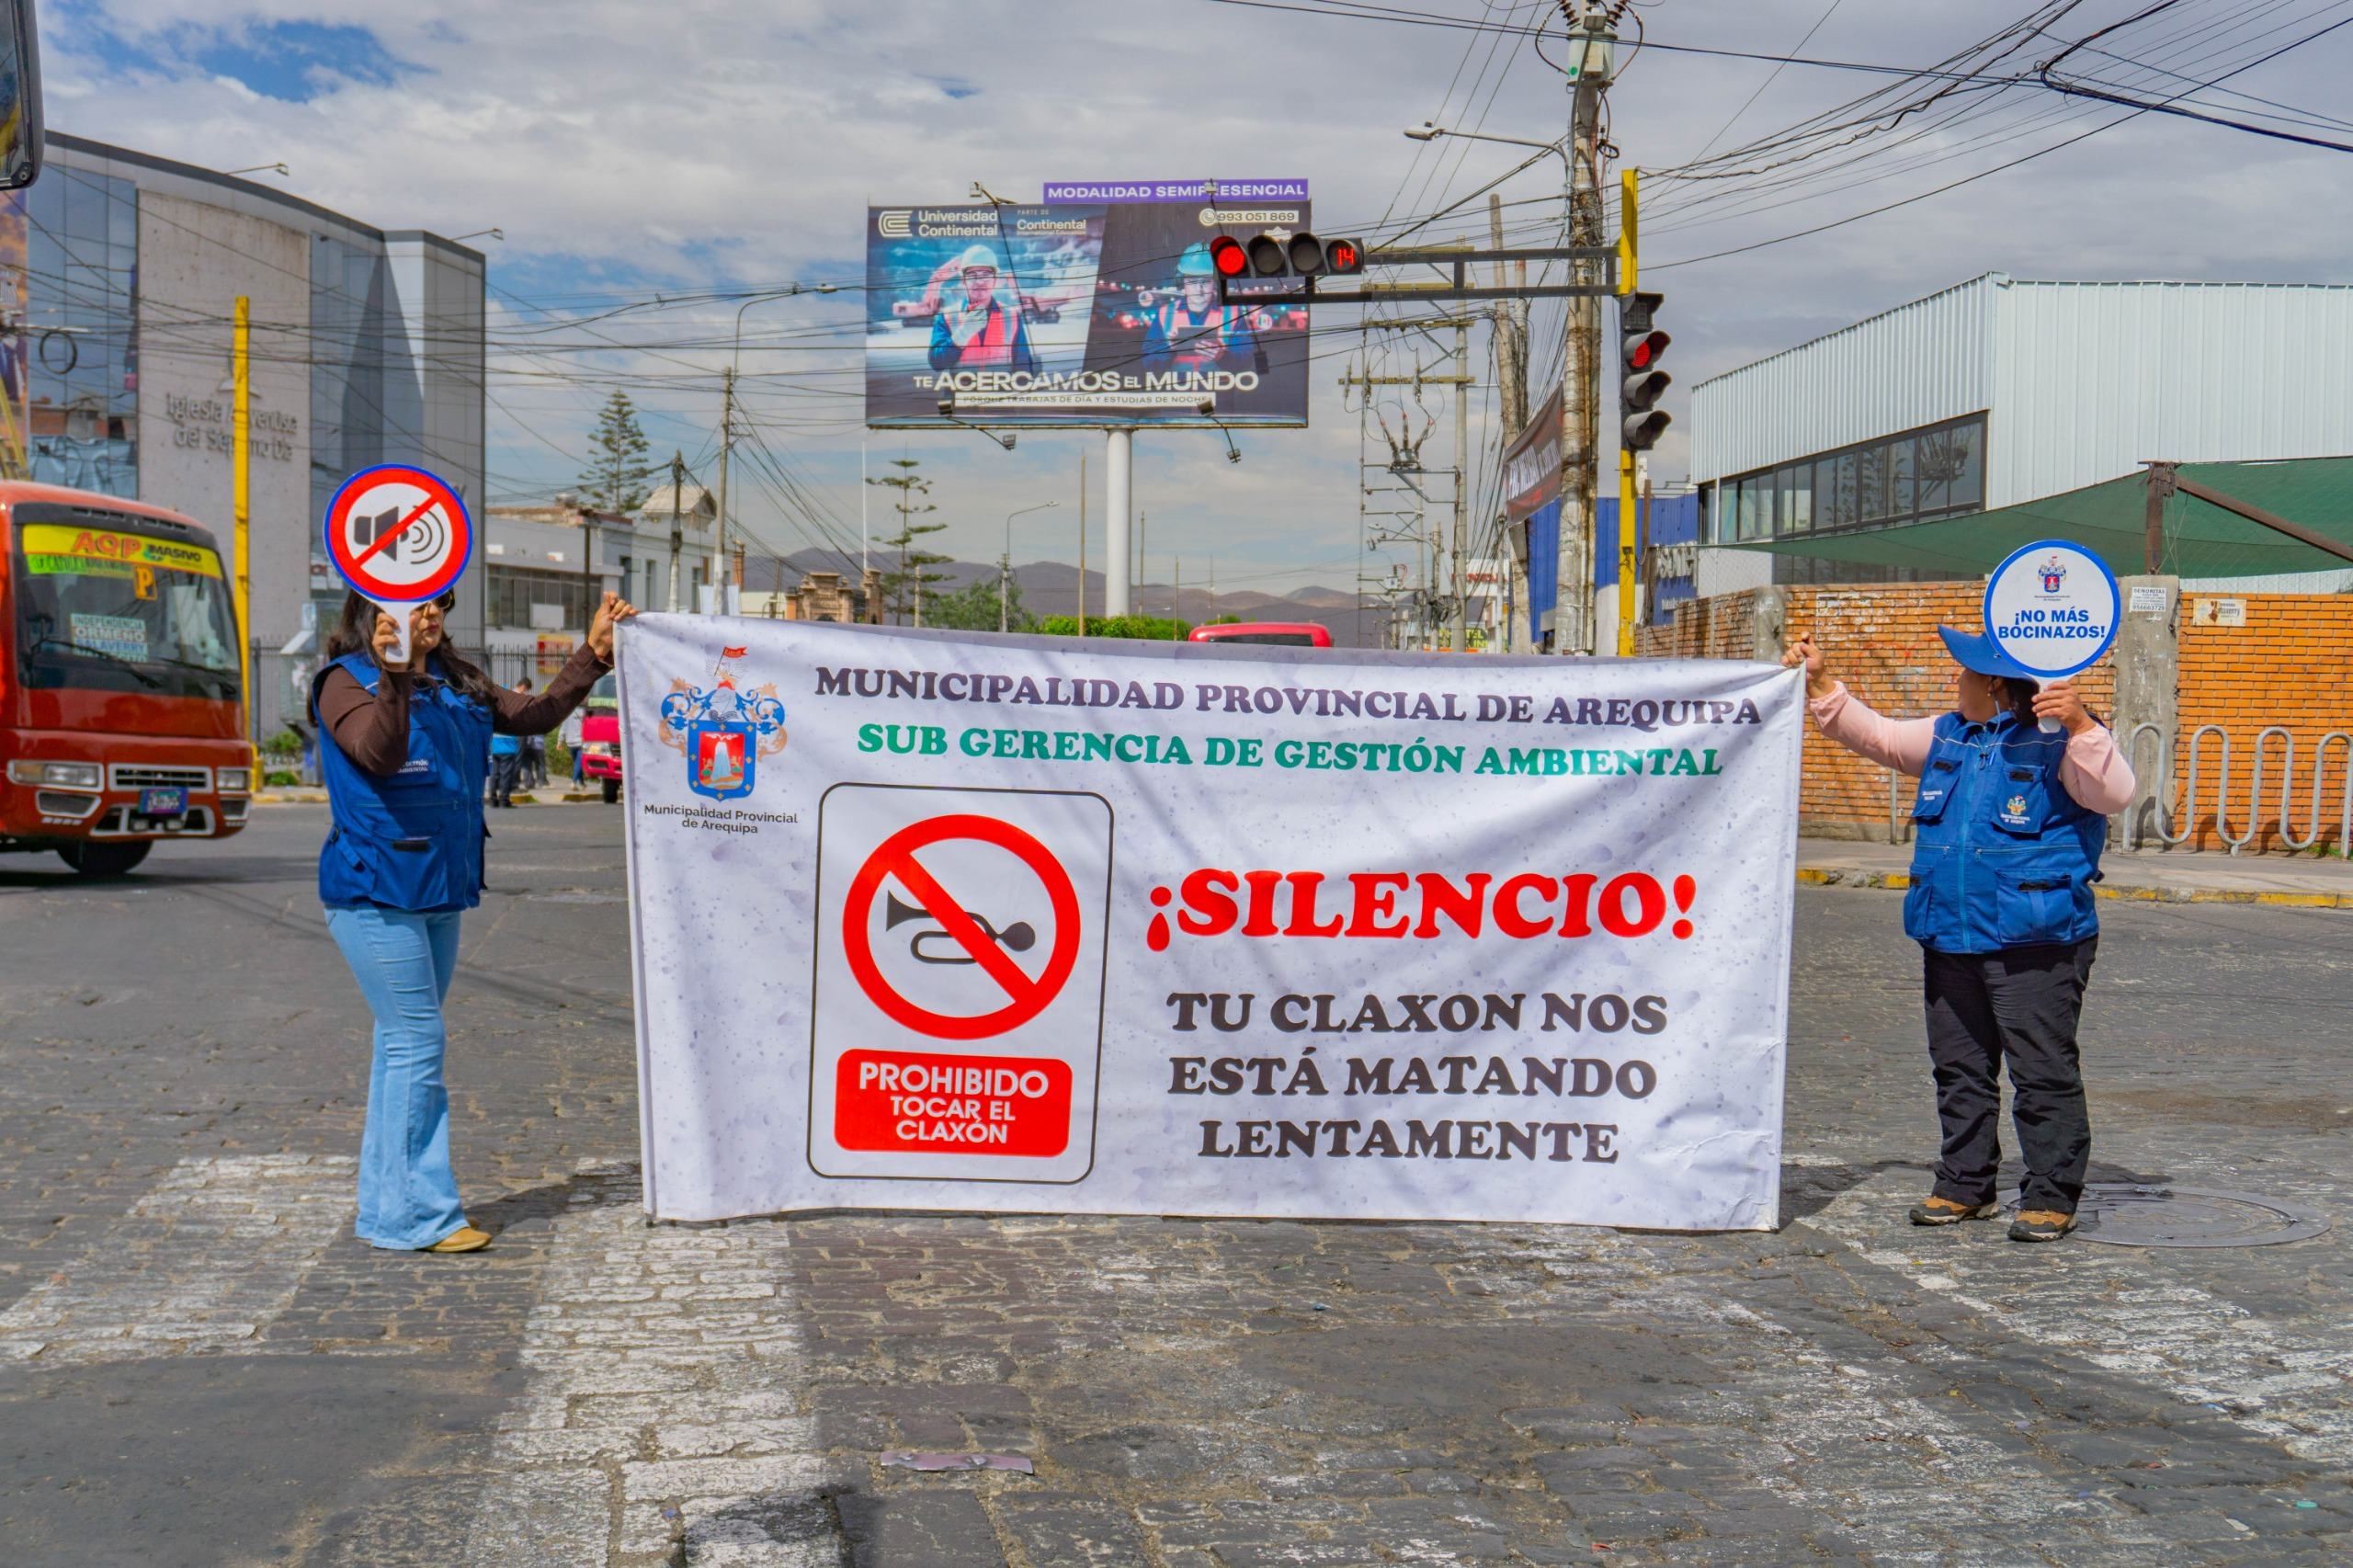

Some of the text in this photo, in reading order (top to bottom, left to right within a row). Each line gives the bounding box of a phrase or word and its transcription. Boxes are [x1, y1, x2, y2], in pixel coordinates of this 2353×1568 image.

[1048, 184, 1304, 199] MODALIDAD SEMIPESENCIAL
[918, 210, 997, 222] Universidad
[918, 219, 1086, 236] Continental Continental
[1218, 211, 1295, 222] 993 051 869
[1337, 248, 1355, 267] 14
[914, 371, 1258, 392] TE ACERCAMOS EL MUNDO
[166, 393, 222, 425] Iglesia
[1074, 394, 1092, 403] DÍA
[71, 531, 142, 559] AQP
[136, 567, 153, 597] P
[2015, 606, 2089, 625] ¡NO MÁS
[1998, 625, 2105, 639] BOCINAZOS!
[815, 666, 1762, 732] MUNICIPALIDAD PROVINCIAL DE AREQUIPA
[858, 723, 1722, 777] SUB GERENCIA DE GESTIÓN AMBIENTAL
[644, 804, 798, 824] Municipalidad Provincial
[682, 818, 758, 835] de Arequipa
[1147, 868, 1697, 952] ¡SILENCIO!
[1166, 993, 1667, 1035] TU CLAXON NOS
[859, 1062, 1049, 1098] PROHIBIDO
[1167, 1047, 1656, 1099] ESTÁ MATANDO
[890, 1096, 1016, 1121] TOCAR EL
[896, 1117, 1007, 1143] CLAXÓN
[1198, 1119, 1618, 1164] LENTAMENTE
